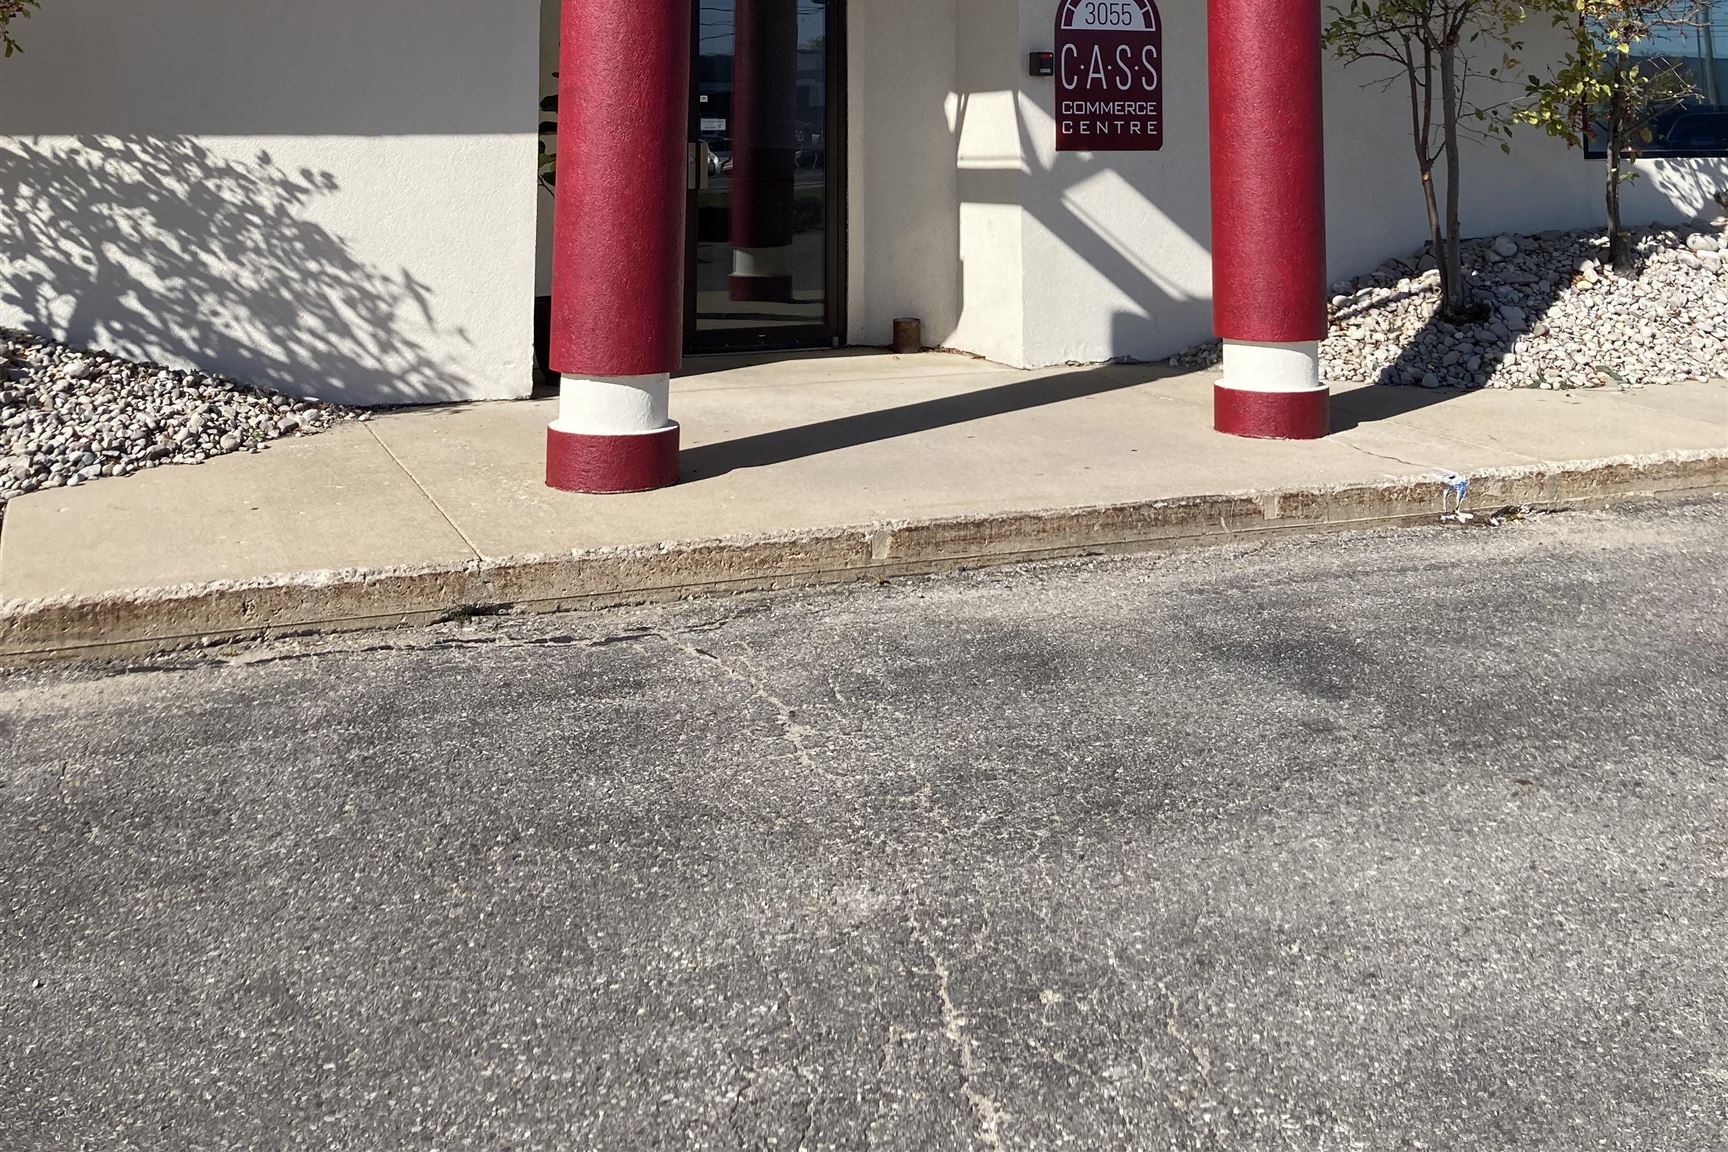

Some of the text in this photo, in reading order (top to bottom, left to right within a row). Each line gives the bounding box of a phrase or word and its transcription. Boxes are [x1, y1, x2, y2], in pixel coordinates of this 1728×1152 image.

[1084, 1, 1132, 26] 3055
[1062, 101, 1157, 115] COMMERCE
[1062, 121, 1158, 135] CENTRE
